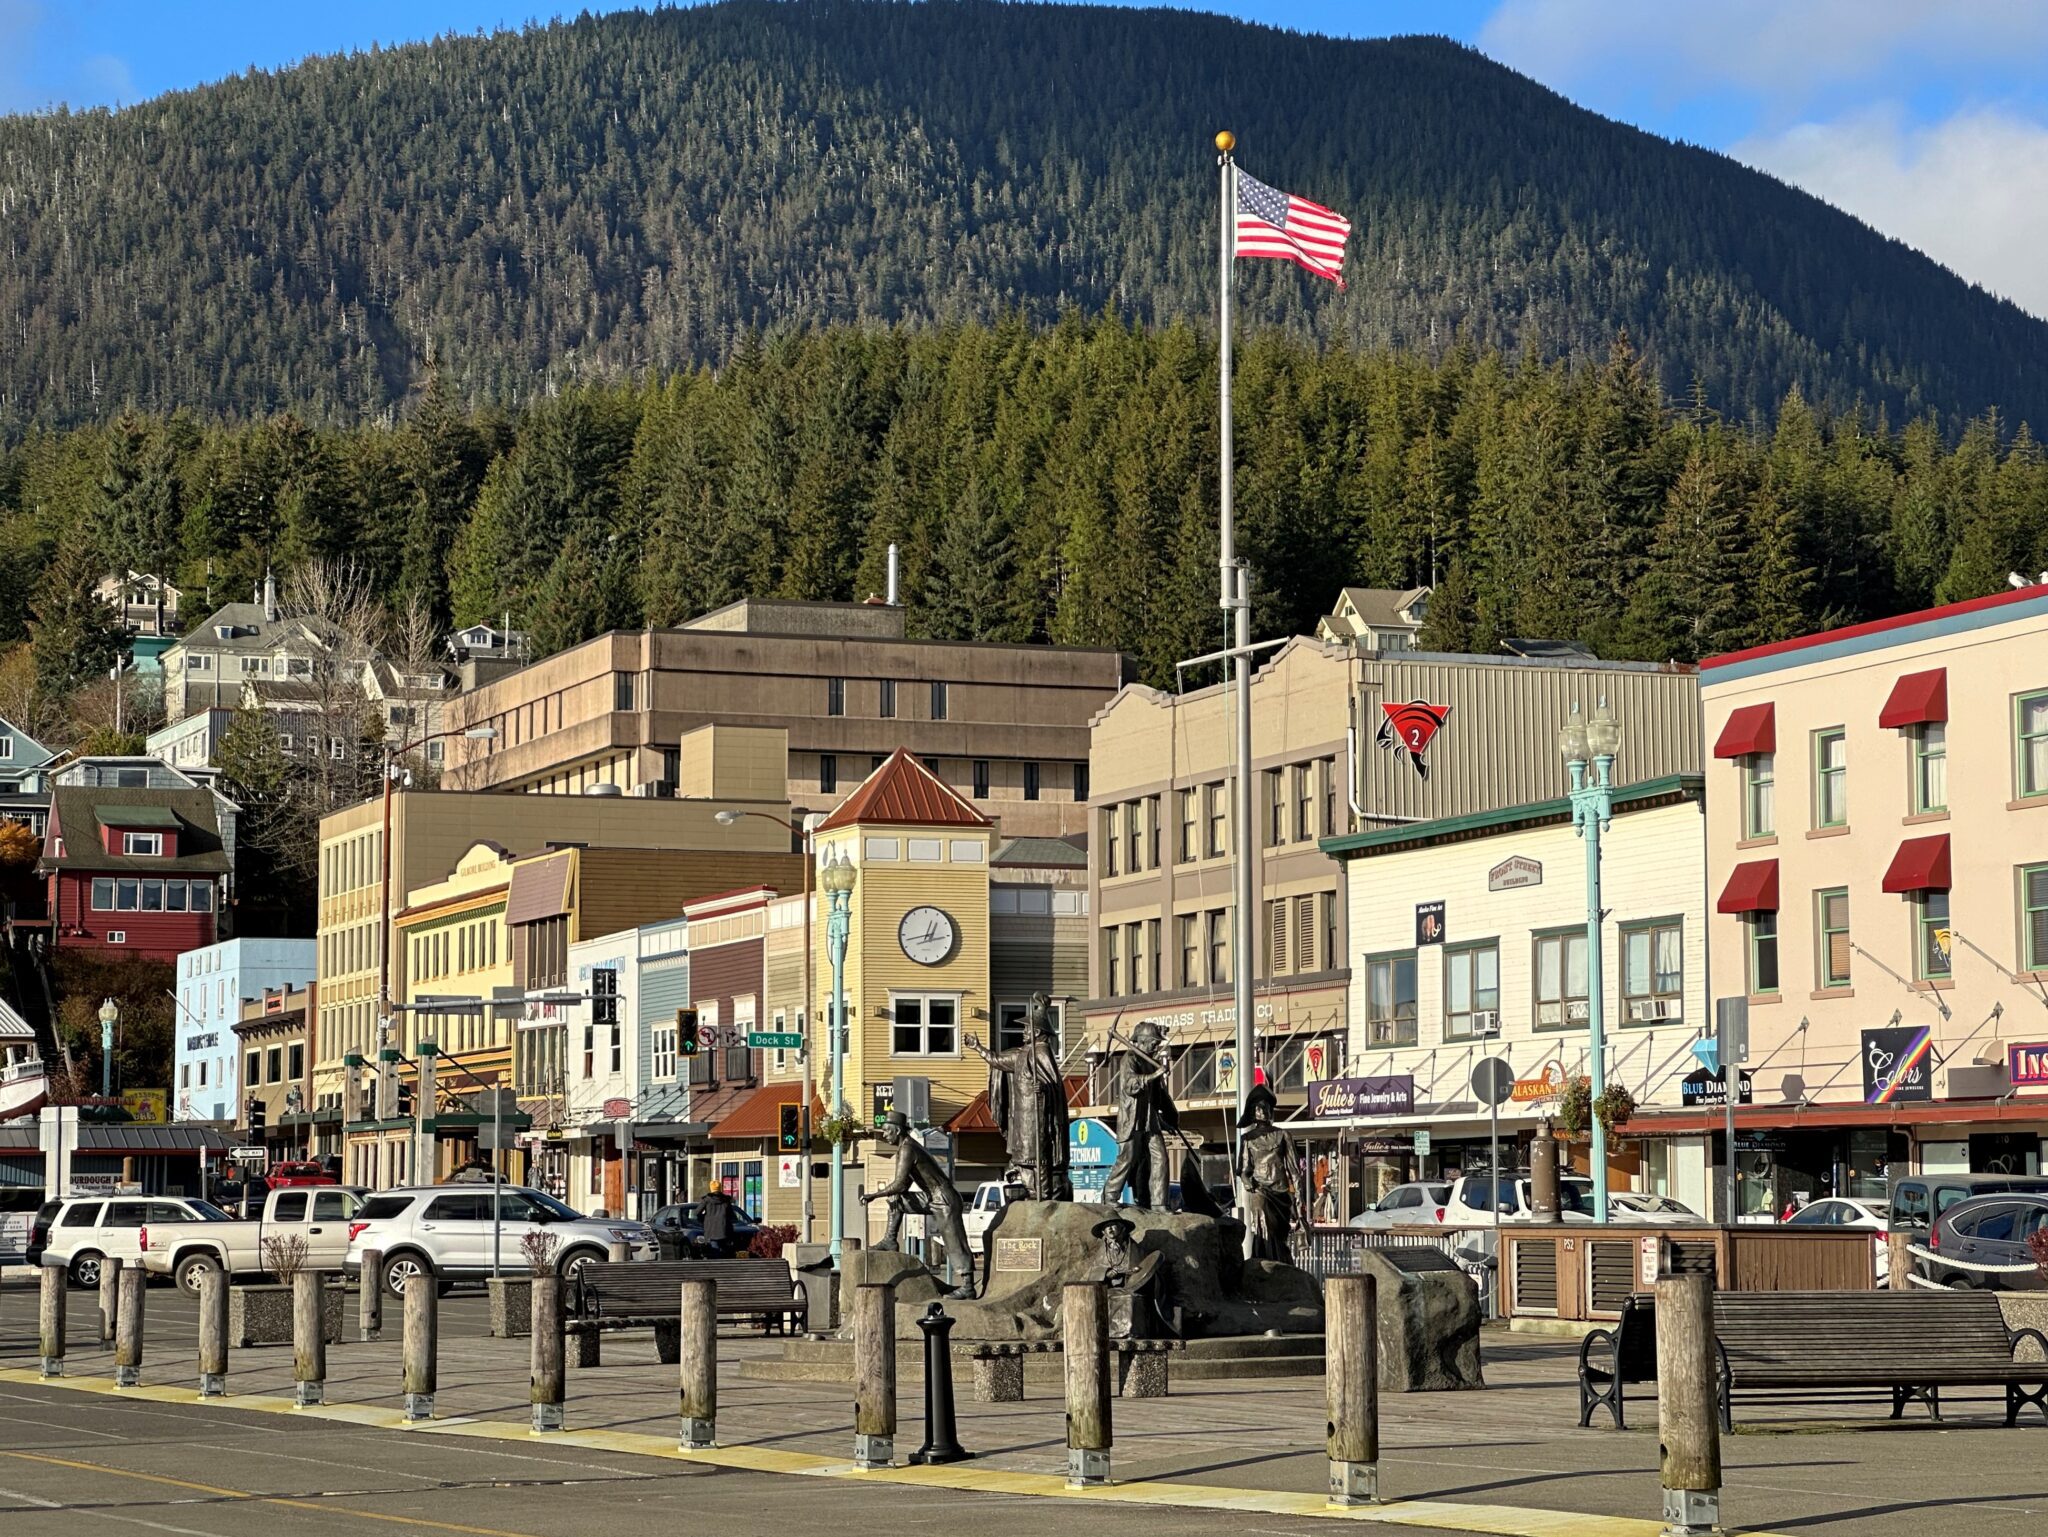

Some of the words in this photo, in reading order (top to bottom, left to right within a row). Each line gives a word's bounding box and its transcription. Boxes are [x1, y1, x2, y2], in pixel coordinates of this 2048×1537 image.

[1411, 729, 1420, 746] 2
[1200, 1008, 1236, 1024] TRADI
[755, 1036, 779, 1045] Dock
[784, 1036, 794, 1045] St
[1869, 1048, 1923, 1091] Colors
[1511, 1083, 1552, 1098] ALASKAN
[1683, 1081, 1704, 1095] BLUE
[1315, 1084, 1356, 1116] Julie's
[1360, 1093, 1370, 1104] Fine
[1371, 1092, 1389, 1105] Jewelry
[1391, 1092, 1395, 1102] &
[1396, 1092, 1407, 1102] Arts
[1070, 1147, 1101, 1163] ETCHIKAN
[70, 1175, 111, 1184] OURDOUGH
[1001, 1240, 1016, 1249] The
[1019, 1240, 1037, 1249] Rock
[1563, 1239, 1574, 1250] PS2
